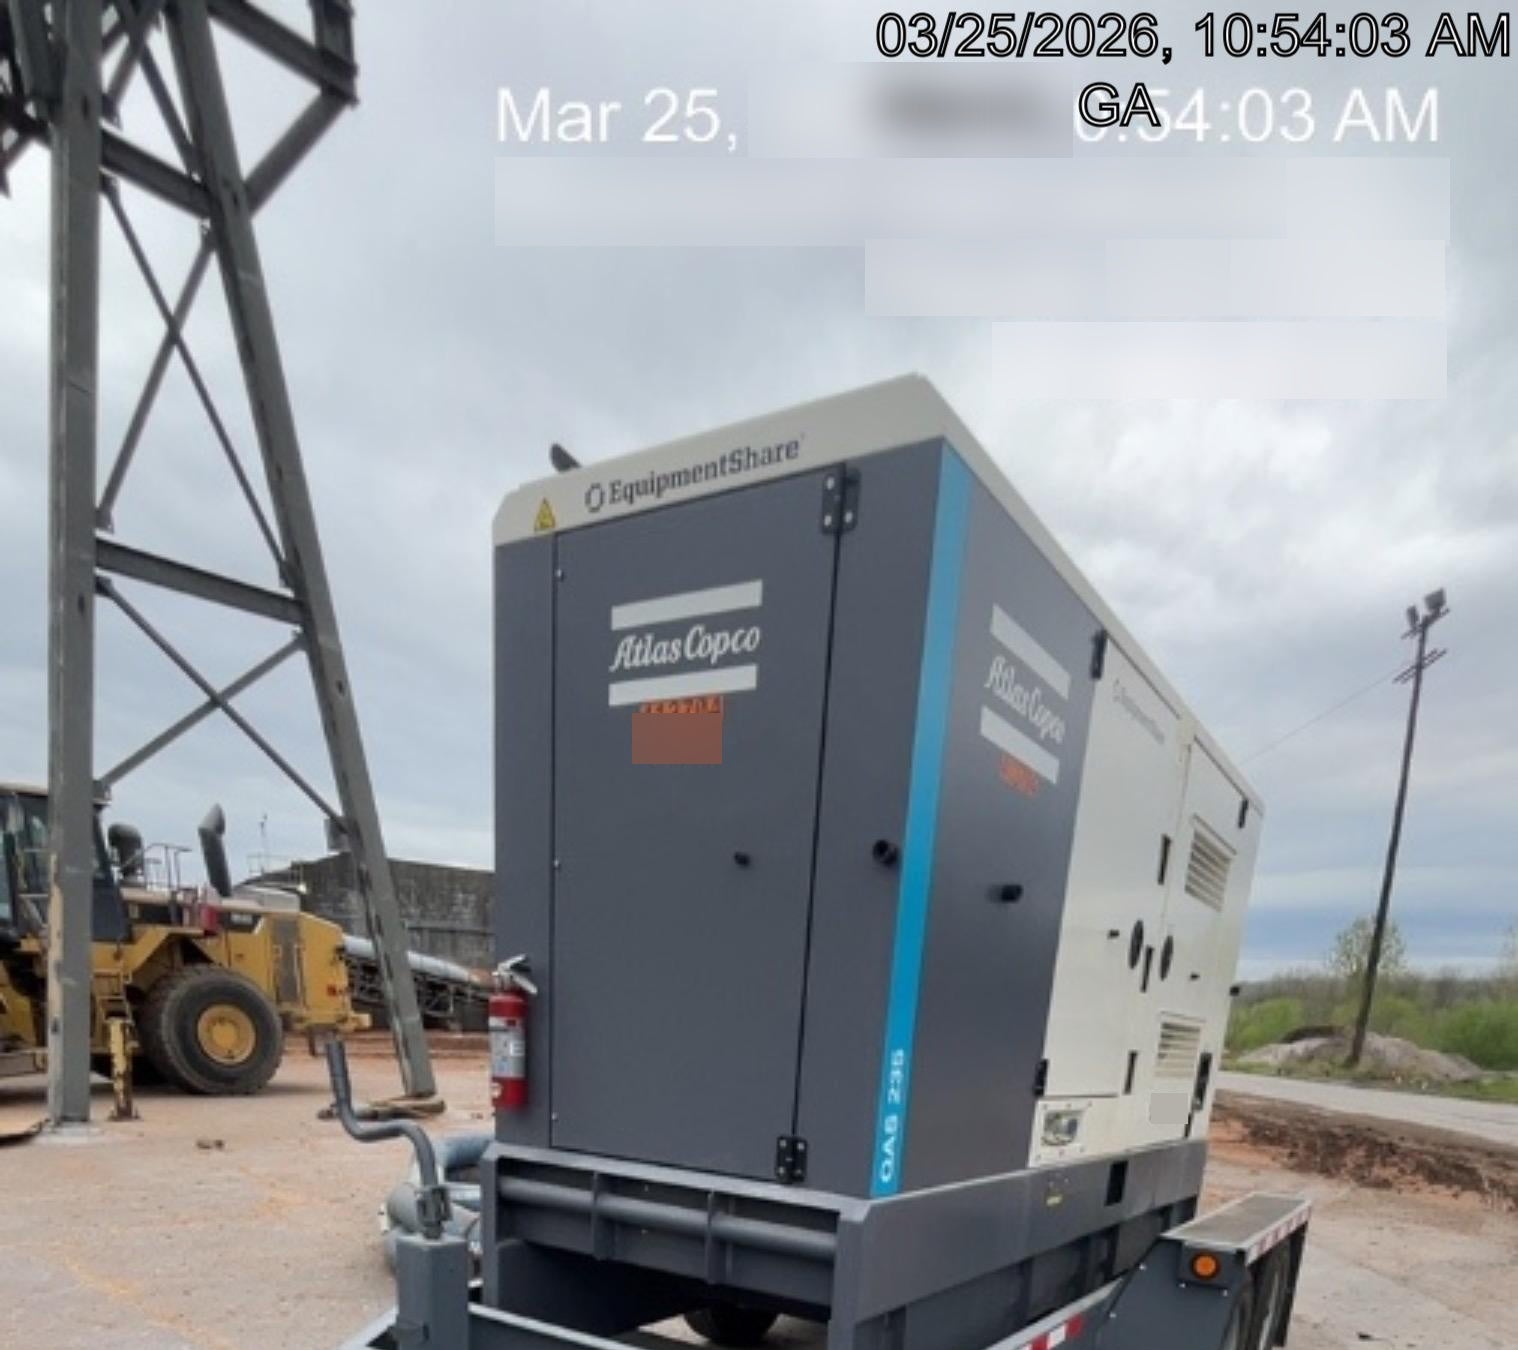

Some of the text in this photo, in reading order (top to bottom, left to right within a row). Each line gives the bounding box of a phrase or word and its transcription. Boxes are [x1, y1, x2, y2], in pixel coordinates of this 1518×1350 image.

[609, 439, 800, 505] EquipmentShare
[608, 624, 761, 672] Atlas Copco
[984, 655, 1027, 718] Atlas
